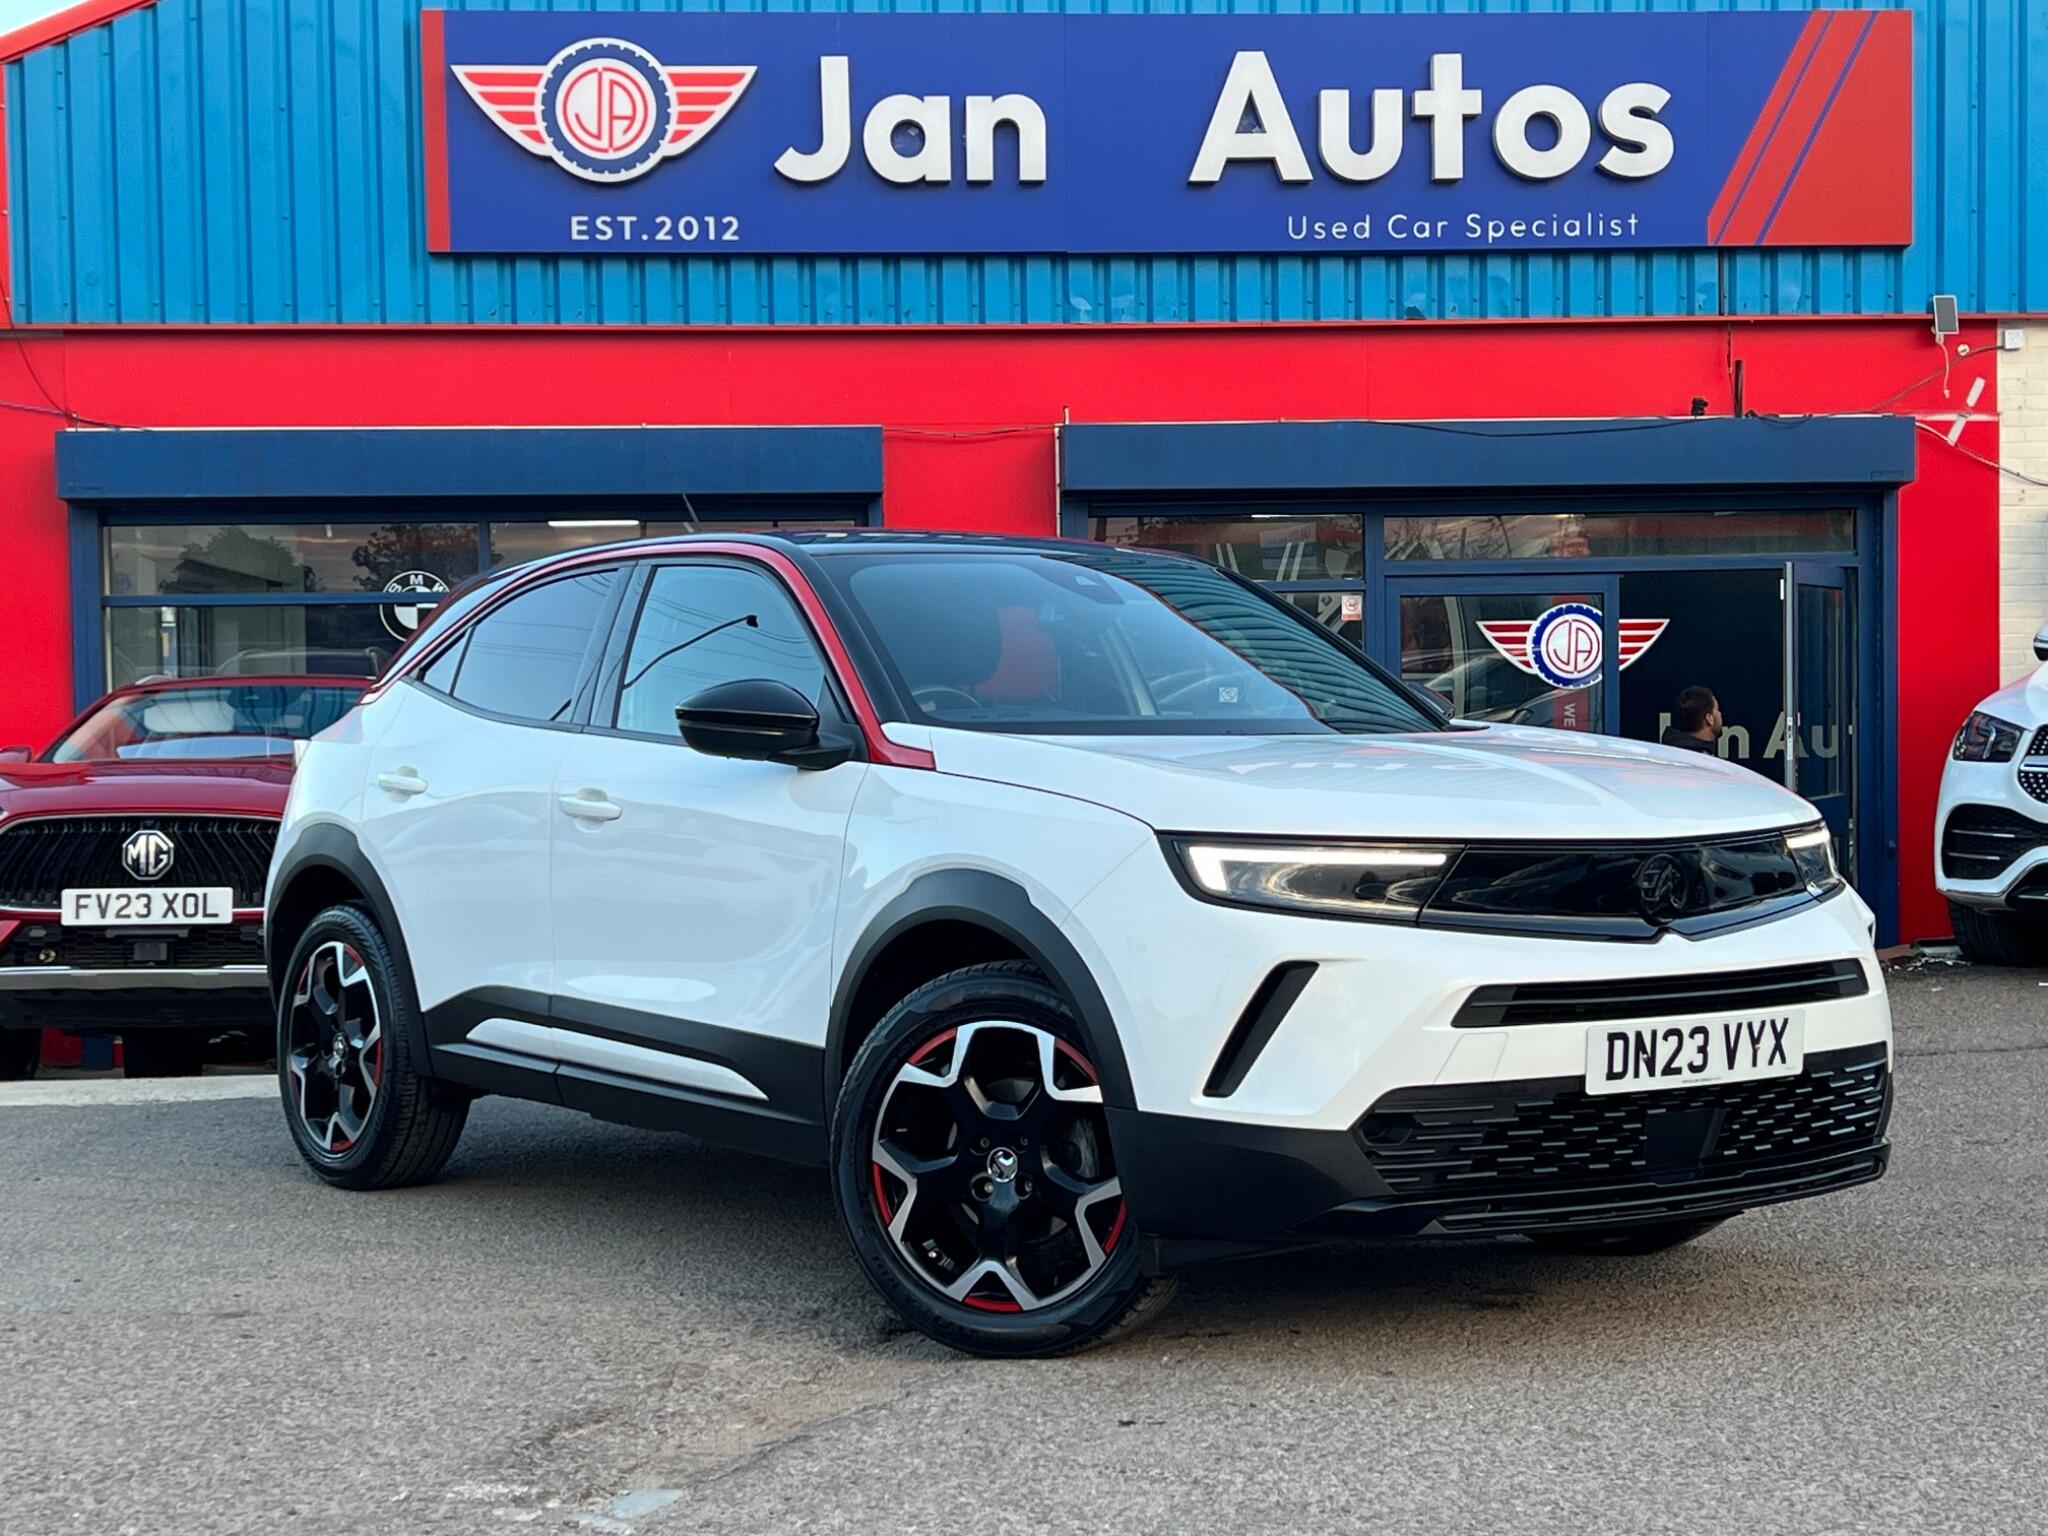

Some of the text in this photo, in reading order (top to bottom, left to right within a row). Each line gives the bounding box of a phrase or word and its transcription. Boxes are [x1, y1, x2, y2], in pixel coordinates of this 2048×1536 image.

[774, 50, 1675, 184] Jan Autos
[570, 215, 741, 242] EST.2012
[1287, 212, 1640, 243] Used Car Specialist
[126, 834, 169, 875] MG
[74, 892, 219, 920] FV23 XOL
[1605, 1017, 1789, 1081] DN23 VYX
